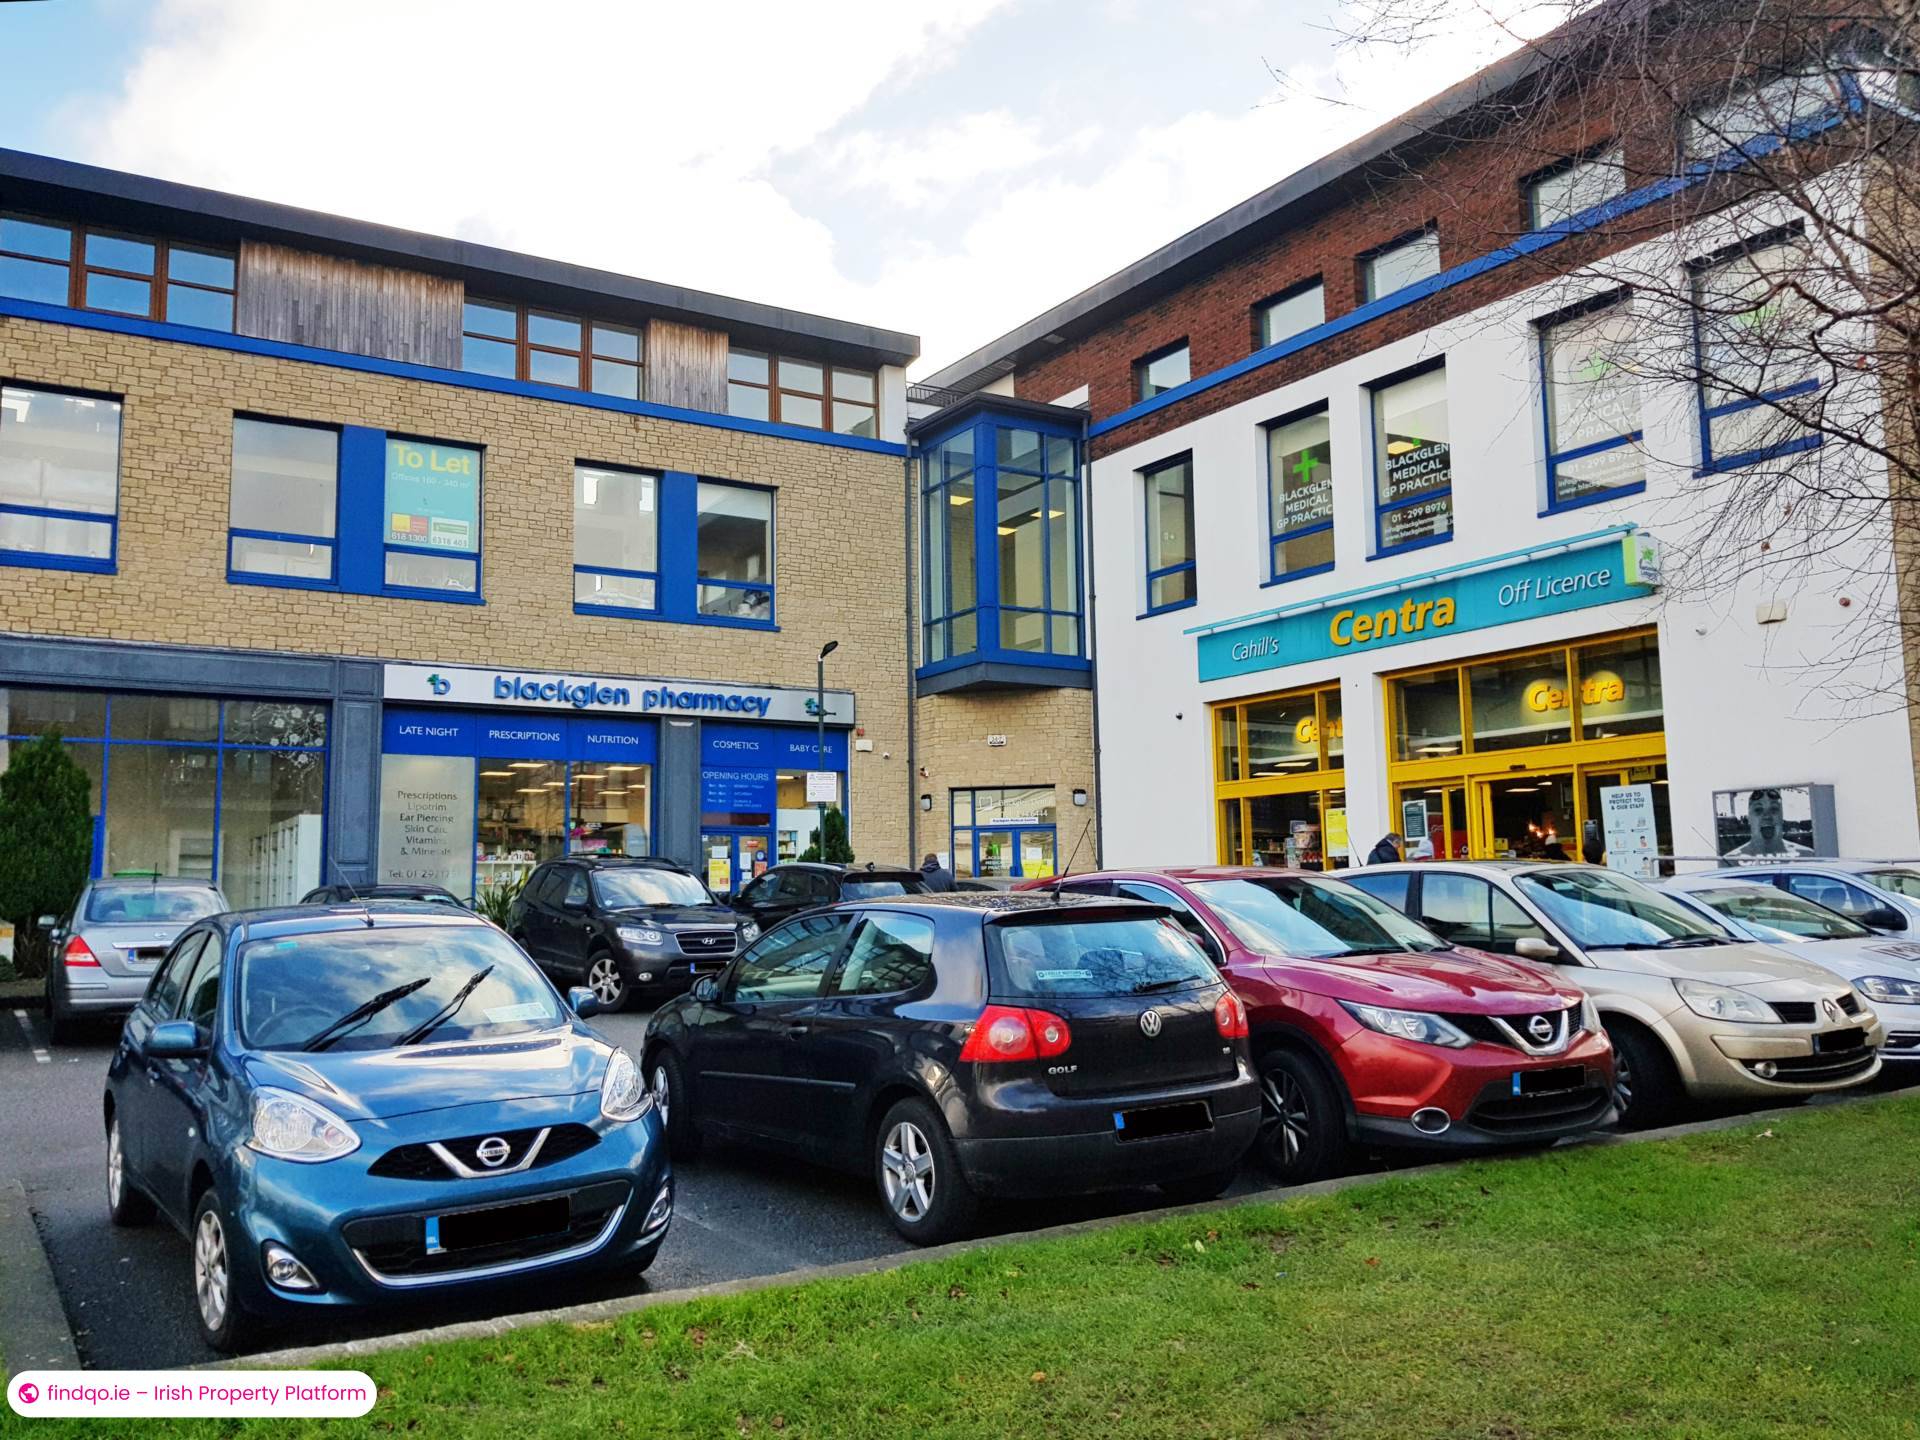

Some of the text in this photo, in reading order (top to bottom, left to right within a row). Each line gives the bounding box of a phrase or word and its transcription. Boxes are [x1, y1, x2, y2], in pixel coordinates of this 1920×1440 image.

[393, 443, 470, 475] To Let
[1385, 443, 1449, 471] BLACKGLEN
[1393, 458, 1443, 482] MEDICAL
[1383, 469, 1453, 497] GP PRACTICE
[1280, 479, 1333, 503] BLACKGLEN
[1286, 493, 1329, 515] MEDICAL
[1277, 504, 1333, 529] GP PRACTIC
[1391, 513, 1401, 523] 01
[1407, 507, 1423, 519] 299
[1499, 579, 1531, 606] Off
[1535, 568, 1611, 599] Licence
[1329, 596, 1456, 646] Centra
[1232, 636, 1280, 661] Cahill's
[494, 675, 771, 717] blackglen pharmacy
[399, 725, 459, 737] LATE NIGHT
[489, 730, 560, 742] PRESCRIPTIONS
[587, 735, 639, 745] NUTRITION
[713, 740, 759, 750] COSMETICS
[790, 744, 833, 754] BABY CRE
[703, 771, 769, 782] OPENING HOURS
[397, 790, 457, 801] Prescriptions
[407, 802, 447, 812] Lipotrim
[400, 813, 454, 823] Ear Piercing
[404, 825, 424, 833] Skin
[411, 848, 451, 856] Mineals
[1048, 1065, 1077, 1075] GOLF
